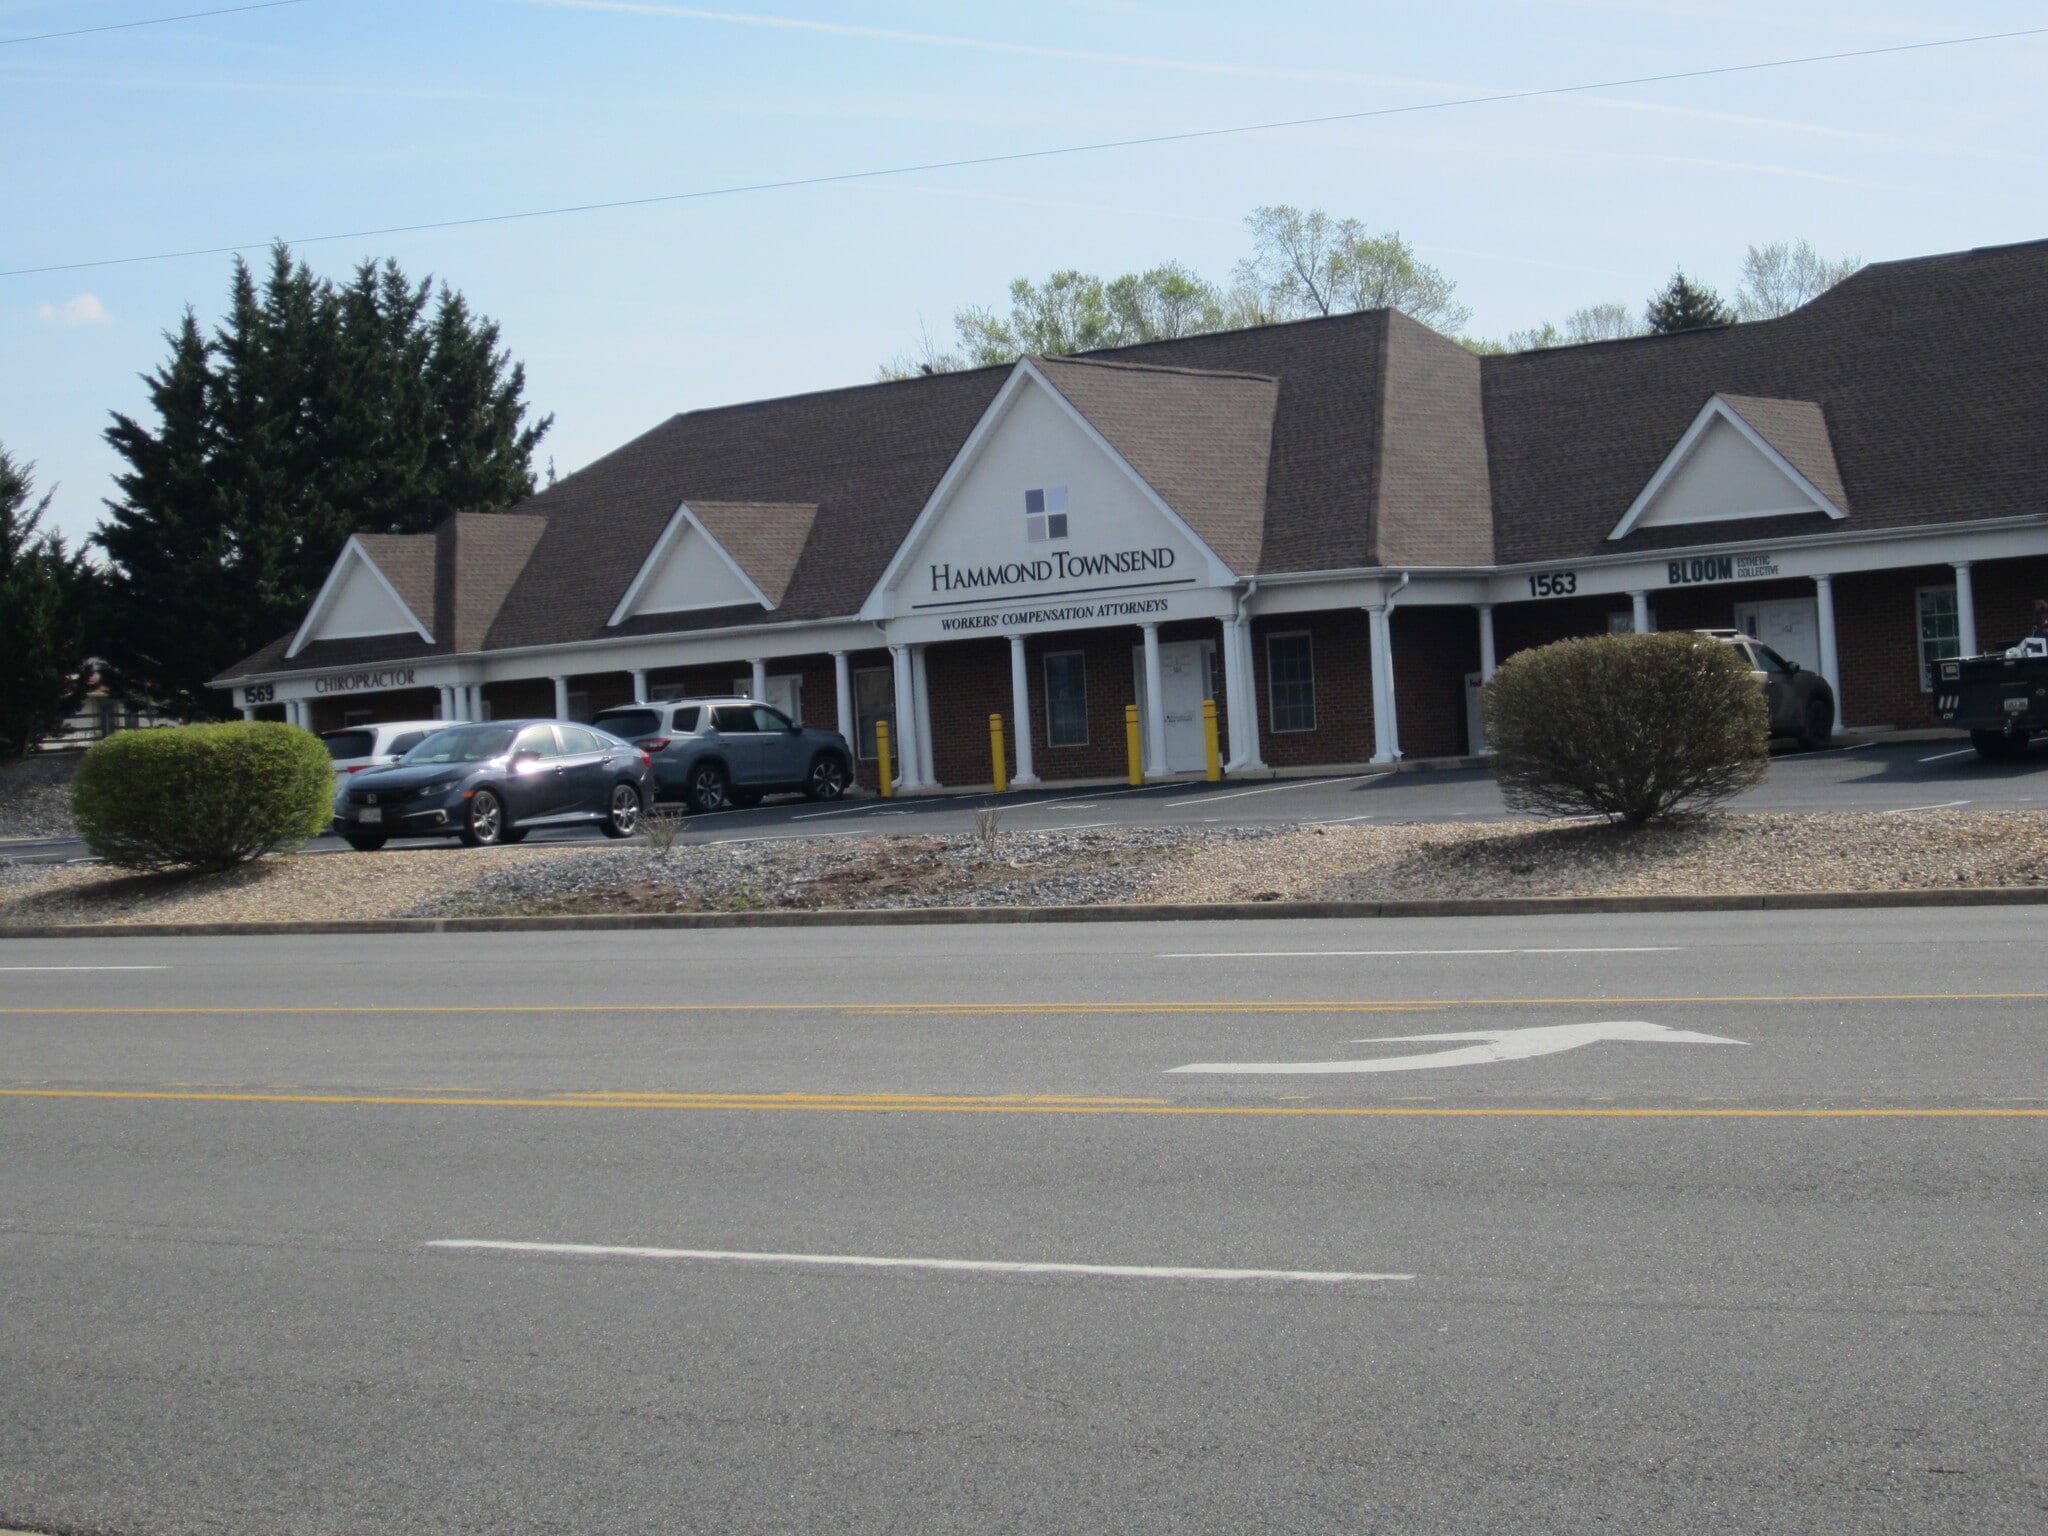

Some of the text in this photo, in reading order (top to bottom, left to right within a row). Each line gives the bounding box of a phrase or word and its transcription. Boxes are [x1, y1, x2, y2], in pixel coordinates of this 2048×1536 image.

[1668, 557, 1733, 584] BLOOM
[1737, 565, 1779, 577] COLLECTIVE
[1529, 572, 1577, 597] 1563
[941, 599, 1168, 631] WORKERS' COMPENSATION ATTORNEYS
[315, 670, 415, 693] CHIROPRACTOR
[244, 684, 274, 704] 1569
